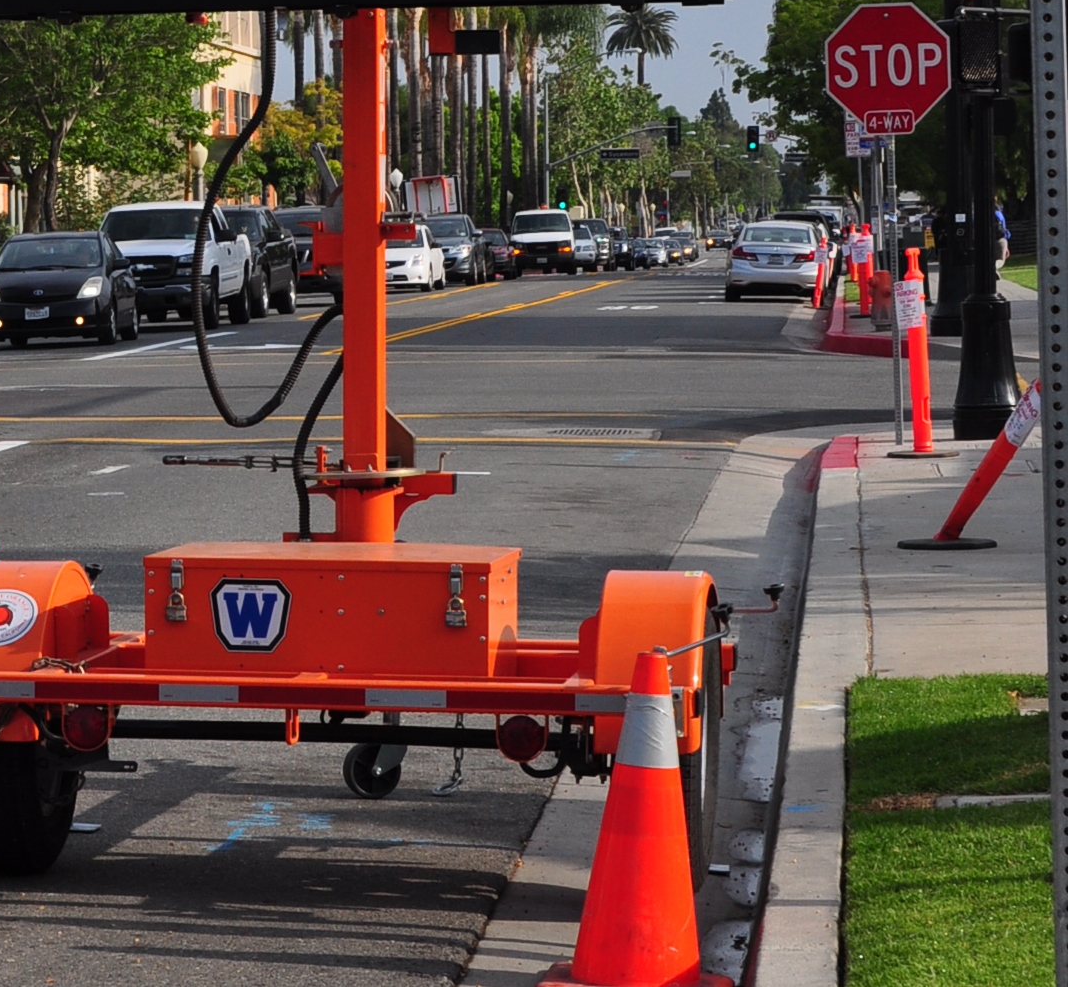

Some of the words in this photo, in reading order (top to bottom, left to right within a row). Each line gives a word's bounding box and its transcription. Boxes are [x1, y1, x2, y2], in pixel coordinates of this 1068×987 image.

[834, 42, 943, 89] STOP
[868, 115, 910, 130] 4-WAY
[222, 592, 278, 639] W
